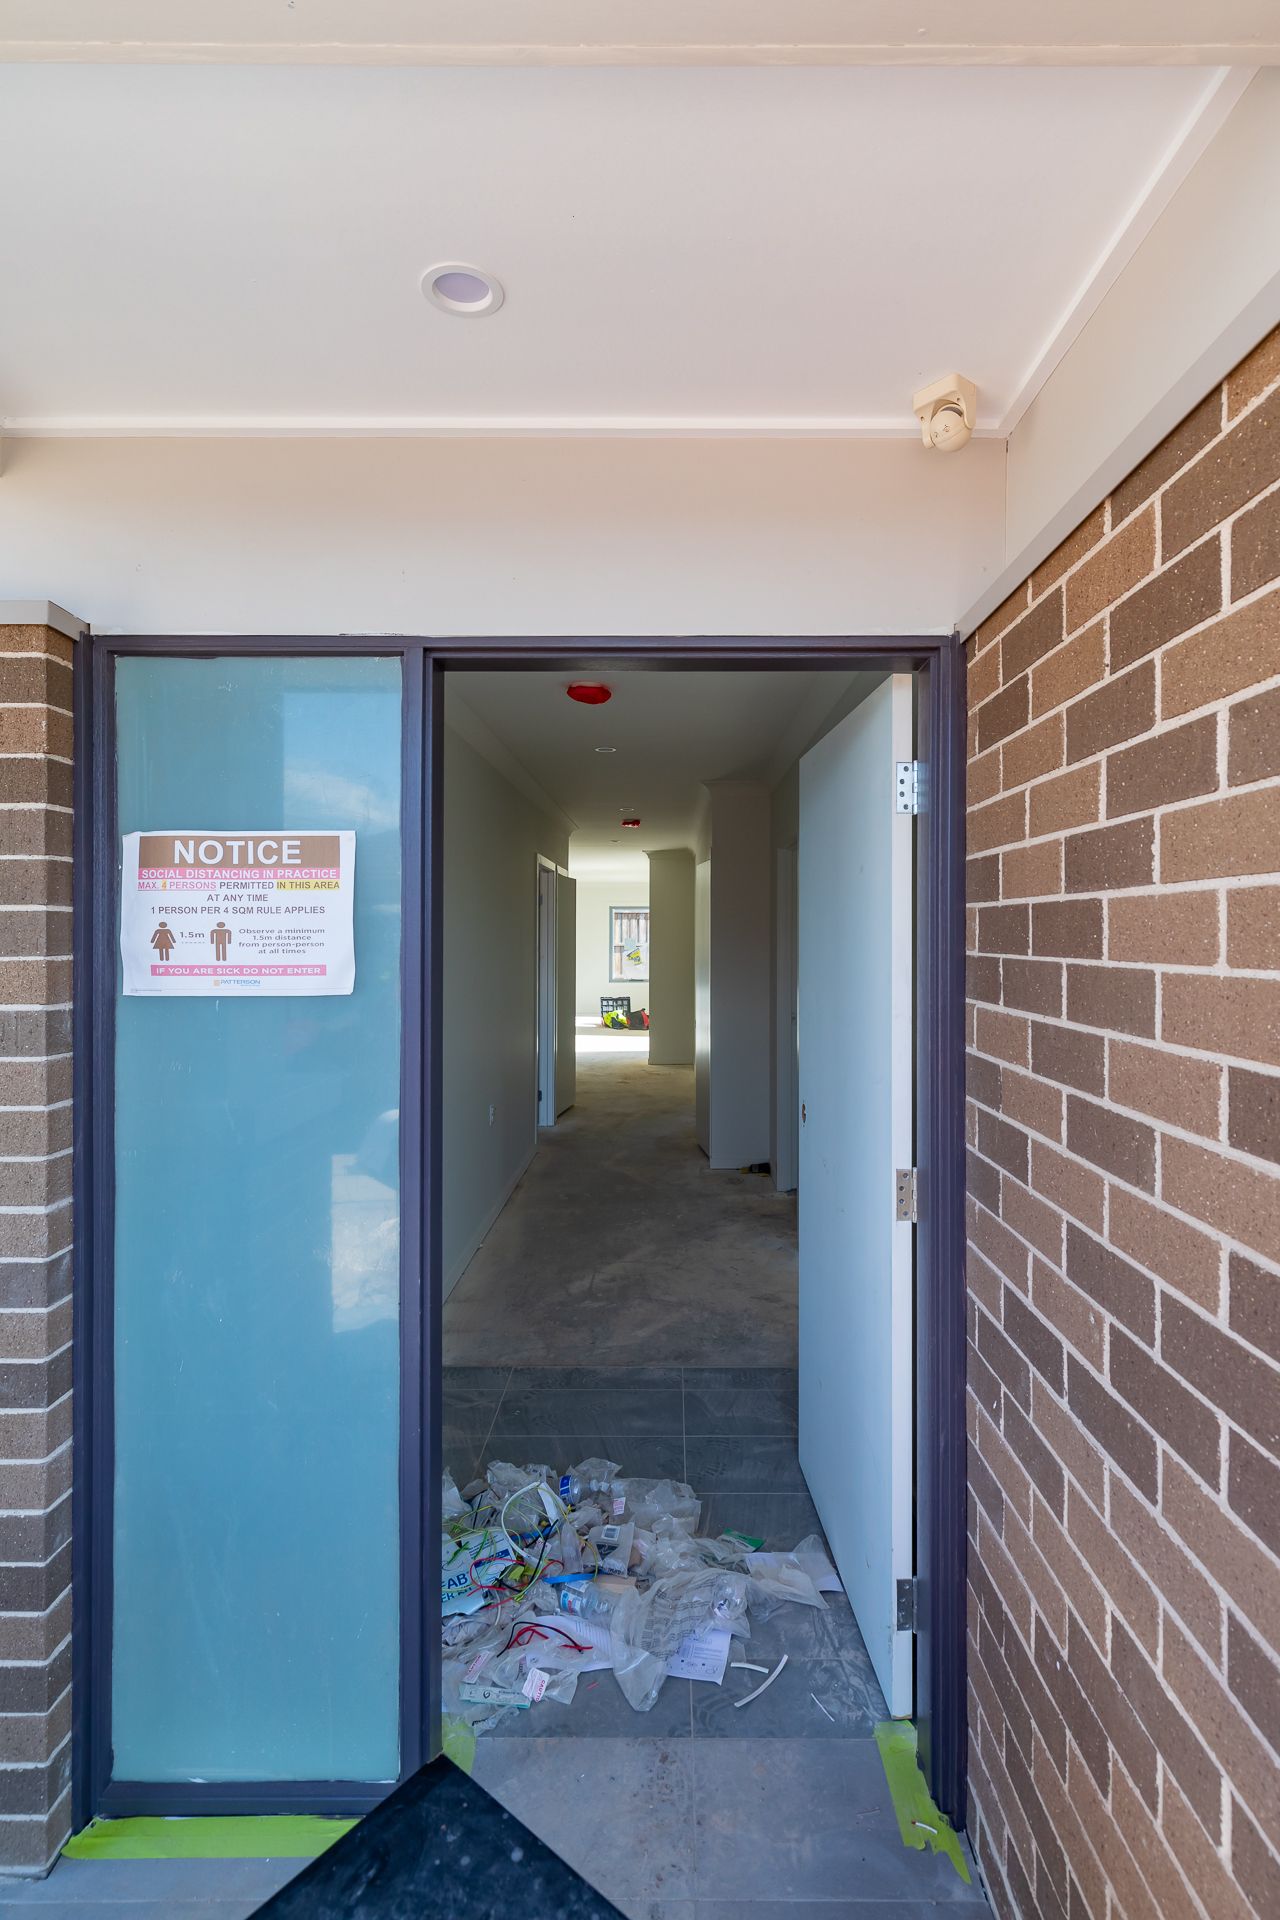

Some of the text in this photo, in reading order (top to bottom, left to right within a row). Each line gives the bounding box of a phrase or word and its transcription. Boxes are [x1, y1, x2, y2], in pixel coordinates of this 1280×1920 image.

[174, 840, 302, 865] NOTICE
[142, 869, 337, 879] SOCIAL DISTANCING IN PRACTICE
[169, 881, 217, 890] PERSONS
[219, 881, 274, 890] PERMITTED
[276, 881, 287, 889] IN
[289, 881, 311, 889] THIS
[313, 881, 340, 889] AREA
[206, 894, 269, 902] AT ANY TIME
[158, 906, 198, 915] PERSON
[201, 906, 221, 915] PER
[223, 906, 229, 915] 4
[232, 906, 254, 915] SQM
[256, 906, 282, 915] RULE
[284, 906, 326, 914] APPLIES
[180, 931, 205, 939] 1.5m
